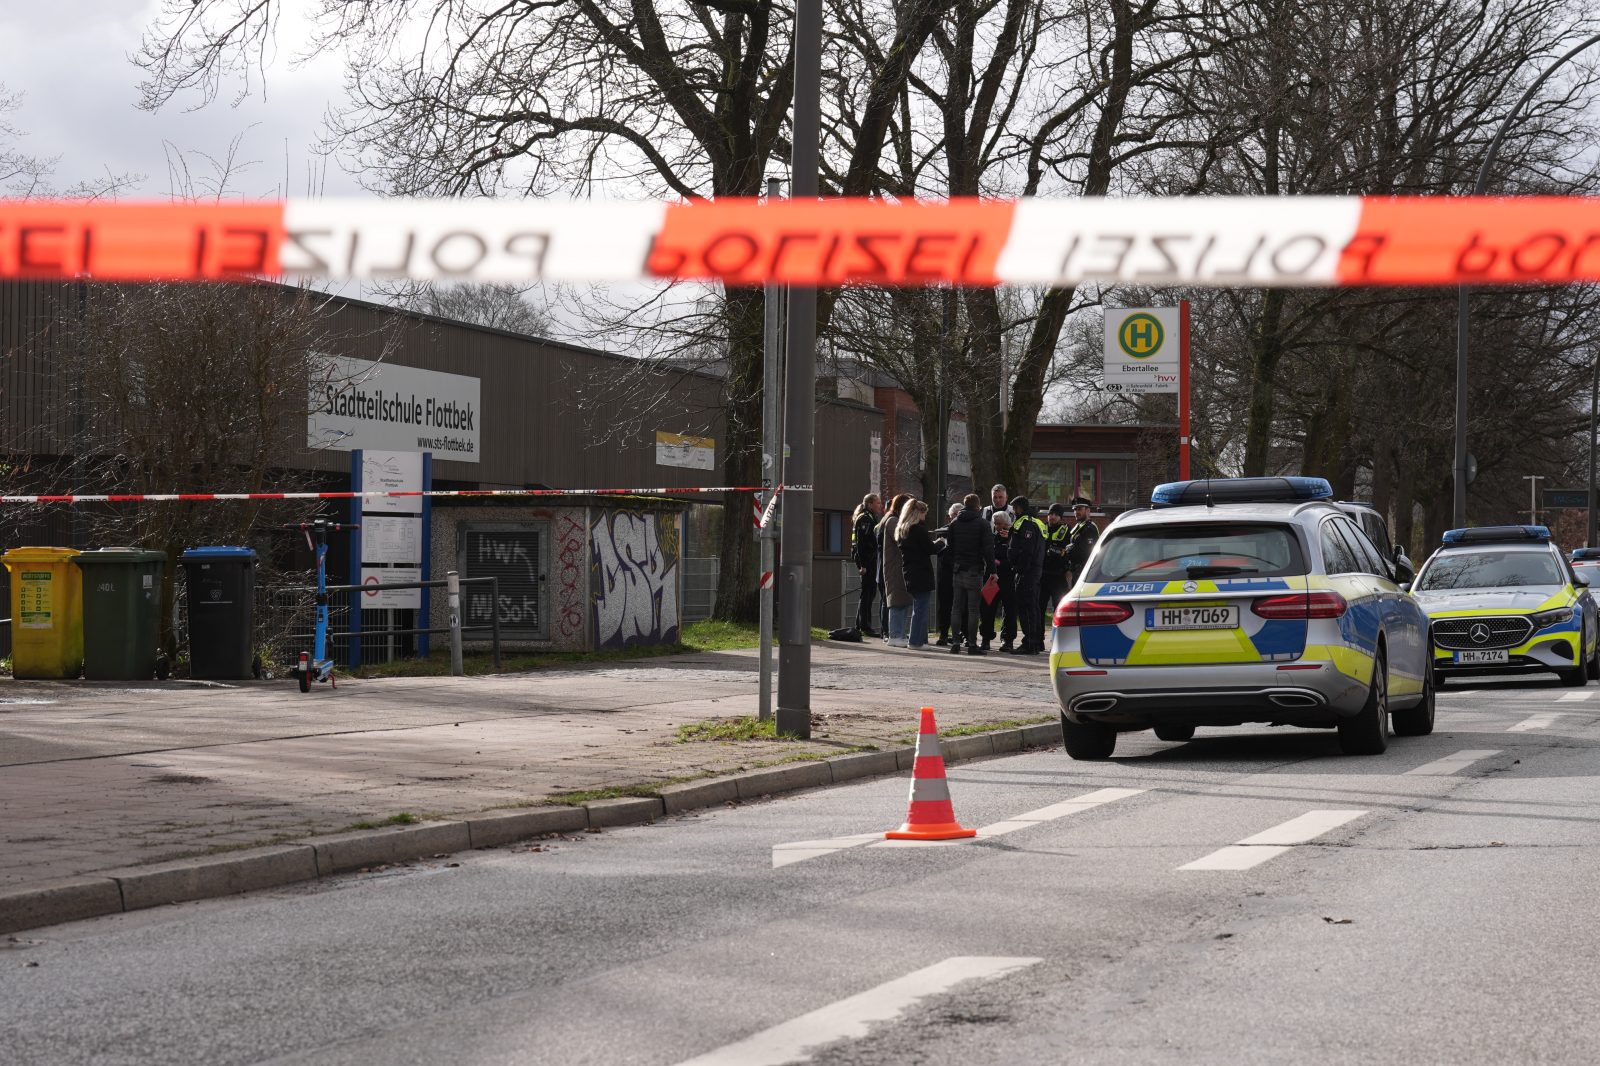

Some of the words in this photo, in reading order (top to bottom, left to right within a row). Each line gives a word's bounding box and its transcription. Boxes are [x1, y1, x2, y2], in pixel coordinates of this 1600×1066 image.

[325, 384, 423, 425] Stadtteilschule
[425, 397, 474, 431] Flottbek
[417, 436, 474, 453] www.sts-flottbek.de
[1108, 584, 1154, 593] POLIZEI
[1162, 609, 1182, 625] HH
[1191, 608, 1230, 624] 7069
[1462, 652, 1476, 661] HH
[1480, 651, 1504, 661] 7174
